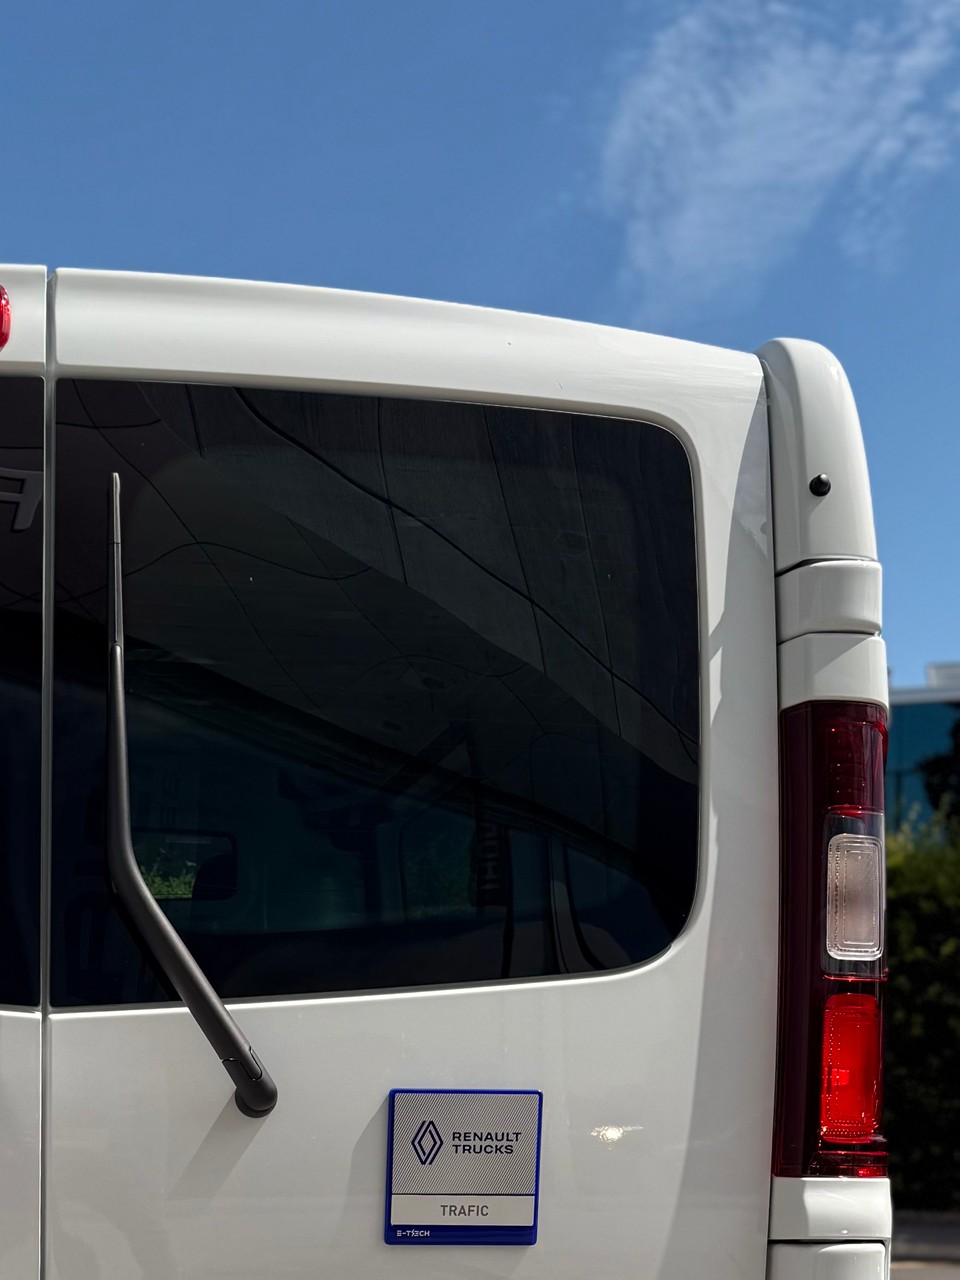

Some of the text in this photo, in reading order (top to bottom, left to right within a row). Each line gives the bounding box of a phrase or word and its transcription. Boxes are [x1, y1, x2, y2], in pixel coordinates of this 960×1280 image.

[452, 1131, 522, 1142] RENAULT
[452, 1144, 514, 1155] TRUCKS
[440, 1204, 489, 1217] TRAFIC
